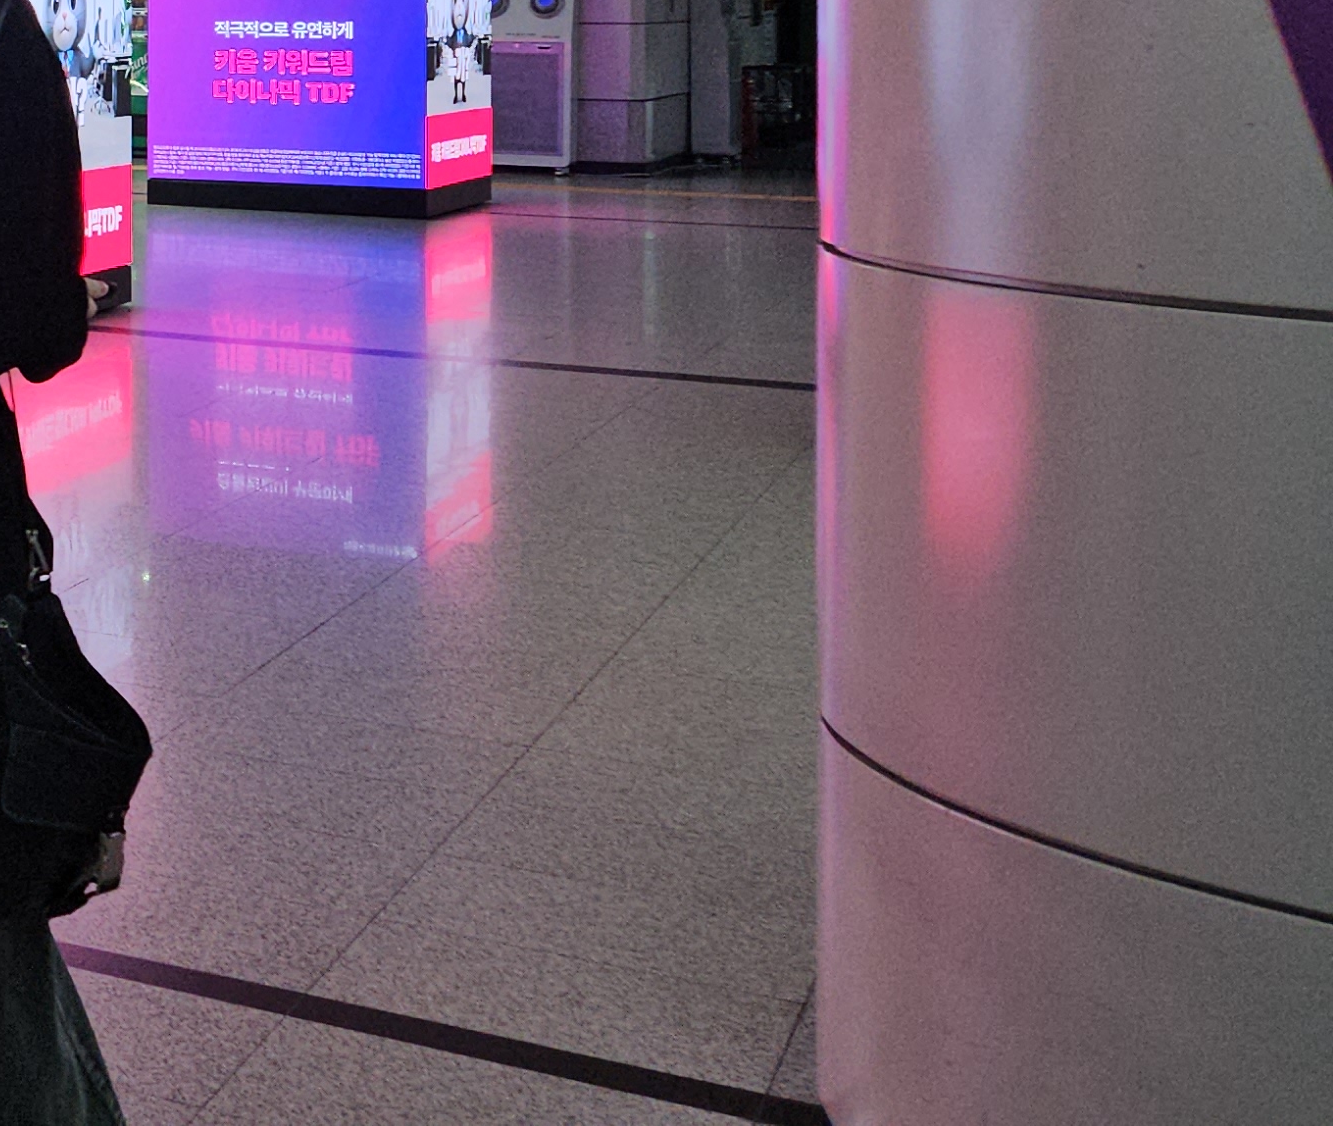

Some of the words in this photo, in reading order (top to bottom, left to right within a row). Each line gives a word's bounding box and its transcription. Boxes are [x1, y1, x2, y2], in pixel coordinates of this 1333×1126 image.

[214, 20, 290, 39] 적극적으로
[292, 20, 354, 39] 유연하게
[214, 48, 259, 75] 키움
[263, 48, 353, 77] 키워드림
[212, 77, 301, 105] 다이나믹
[305, 80, 356, 104] TDF
